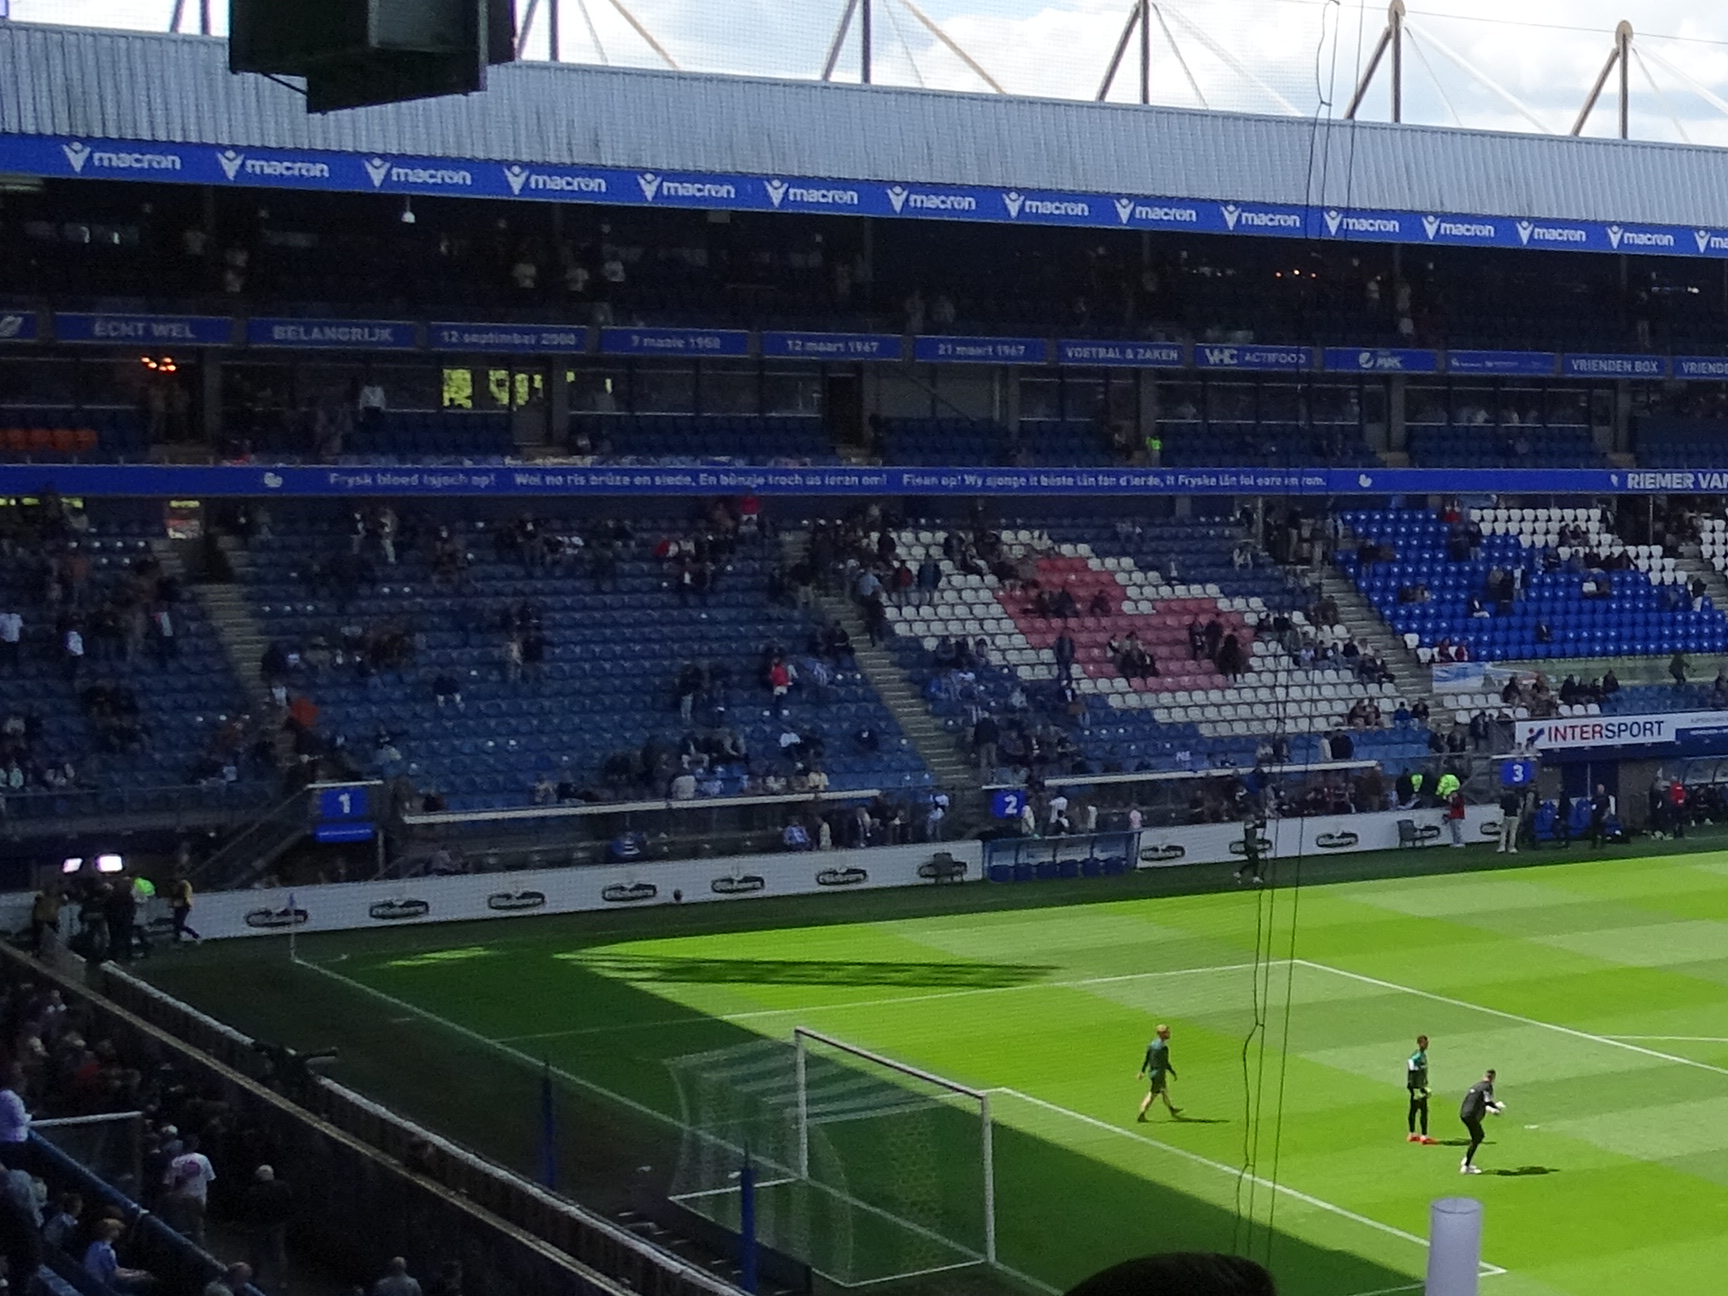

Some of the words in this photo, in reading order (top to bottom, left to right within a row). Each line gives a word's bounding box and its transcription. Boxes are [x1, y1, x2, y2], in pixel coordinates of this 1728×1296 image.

[93, 151, 181, 170] macron
[246, 157, 330, 177] macron
[391, 166, 471, 185] macron
[530, 175, 607, 193] macron
[662, 181, 735, 198] macron
[788, 187, 859, 204] macron
[909, 193, 976, 210] macron
[1024, 200, 1089, 216] macron
[1135, 206, 1196, 222] macron
[1241, 211, 1300, 227] macron
[1343, 218, 1399, 232] macron
[1440, 222, 1494, 238] macron
[1533, 227, 1585, 242] macron
[1623, 231, 1674, 246] macron
[94, 319, 145, 337] ECHT
[152, 321, 198, 340] WEL
[272, 324, 394, 342] BELANGRIJK
[787, 339, 803, 352] 12
[848, 341, 881, 354] 1967
[1066, 347, 1122, 359] VOETBAL
[1125, 348, 1134, 360] &
[1136, 348, 1178, 361] ZAKEN
[1204, 348, 1238, 365] VHC
[1245, 352, 1306, 364] ACTIFOOD
[1571, 359, 1632, 373] VRIENDEN
[1634, 360, 1659, 374] BOX
[330, 473, 372, 487] Frysk
[377, 474, 419, 485] bloed
[545, 475, 563, 486] no
[633, 475, 652, 486] en
[699, 473, 717, 485] En
[768, 474, 803, 485] troch
[861, 474, 887, 486] om!
[902, 473, 938, 486] Flean
[964, 475, 983, 487] Wy
[1178, 474, 1217, 488] Fryske
[1627, 473, 1694, 489] RIEMER
[1548, 719, 1665, 743] INTERSPORT
[1513, 763, 1524, 782] 3
[338, 792, 351, 814] 1
[1004, 793, 1018, 815] 2
